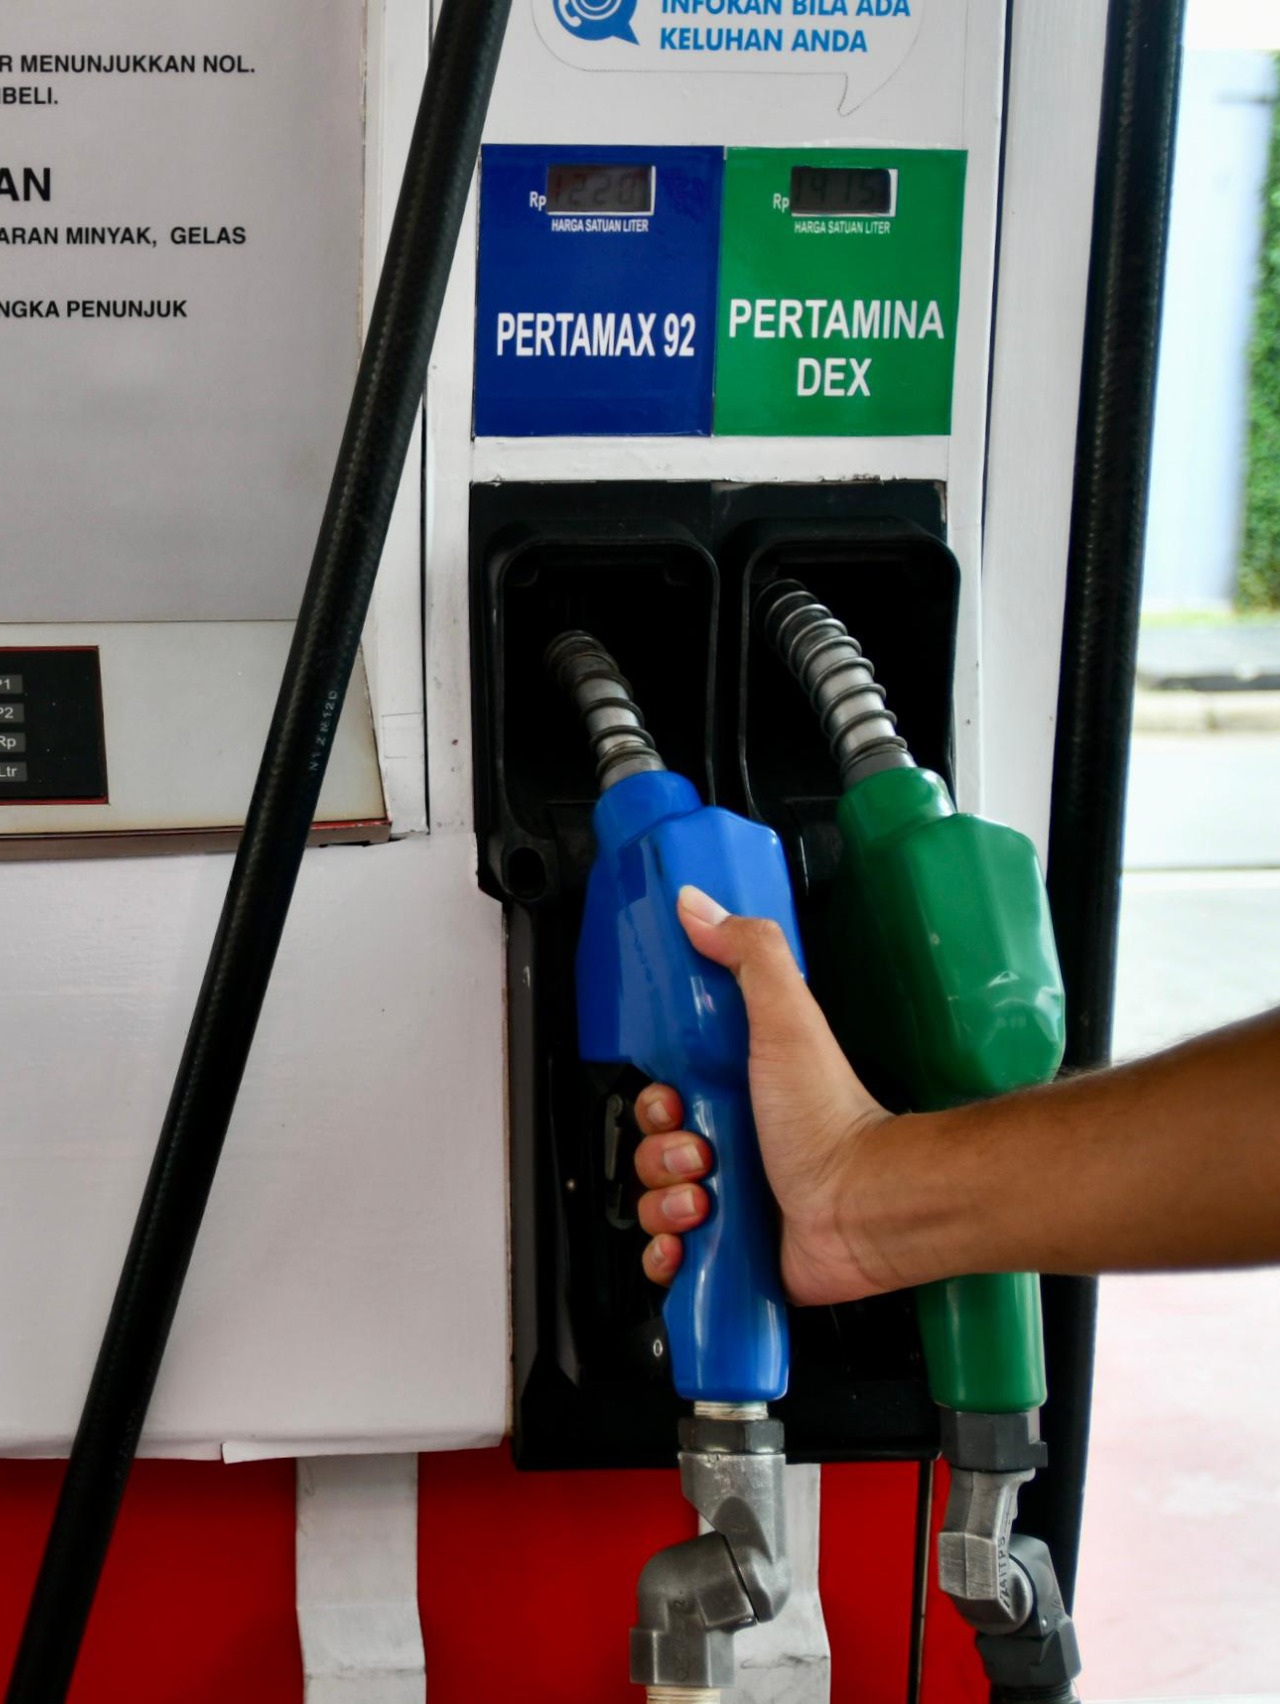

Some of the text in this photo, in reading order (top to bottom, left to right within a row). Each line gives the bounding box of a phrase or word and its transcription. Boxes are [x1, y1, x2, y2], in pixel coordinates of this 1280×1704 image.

[662, 0, 910, 16] INFOKAN BILA ADA
[660, 27, 867, 52] KELUHAN ANDA
[20, 54, 195, 73] MENUNJUKKAN
[203, 54, 255, 73] NOL.
[529, 190, 547, 211] Rp
[772, 192, 790, 213] Rp
[551, 218, 649, 232] HARGA SATUAN LITER
[794, 220, 891, 234] HARGA SATUAN LITER
[66, 226, 157, 247] MINYAK,
[170, 226, 246, 245] GELAS
[66, 300, 187, 318] PENUNJUK
[729, 298, 944, 339] PERTAMINA
[497, 312, 696, 357] PERTAMAX 92
[797, 357, 872, 397] DEX
